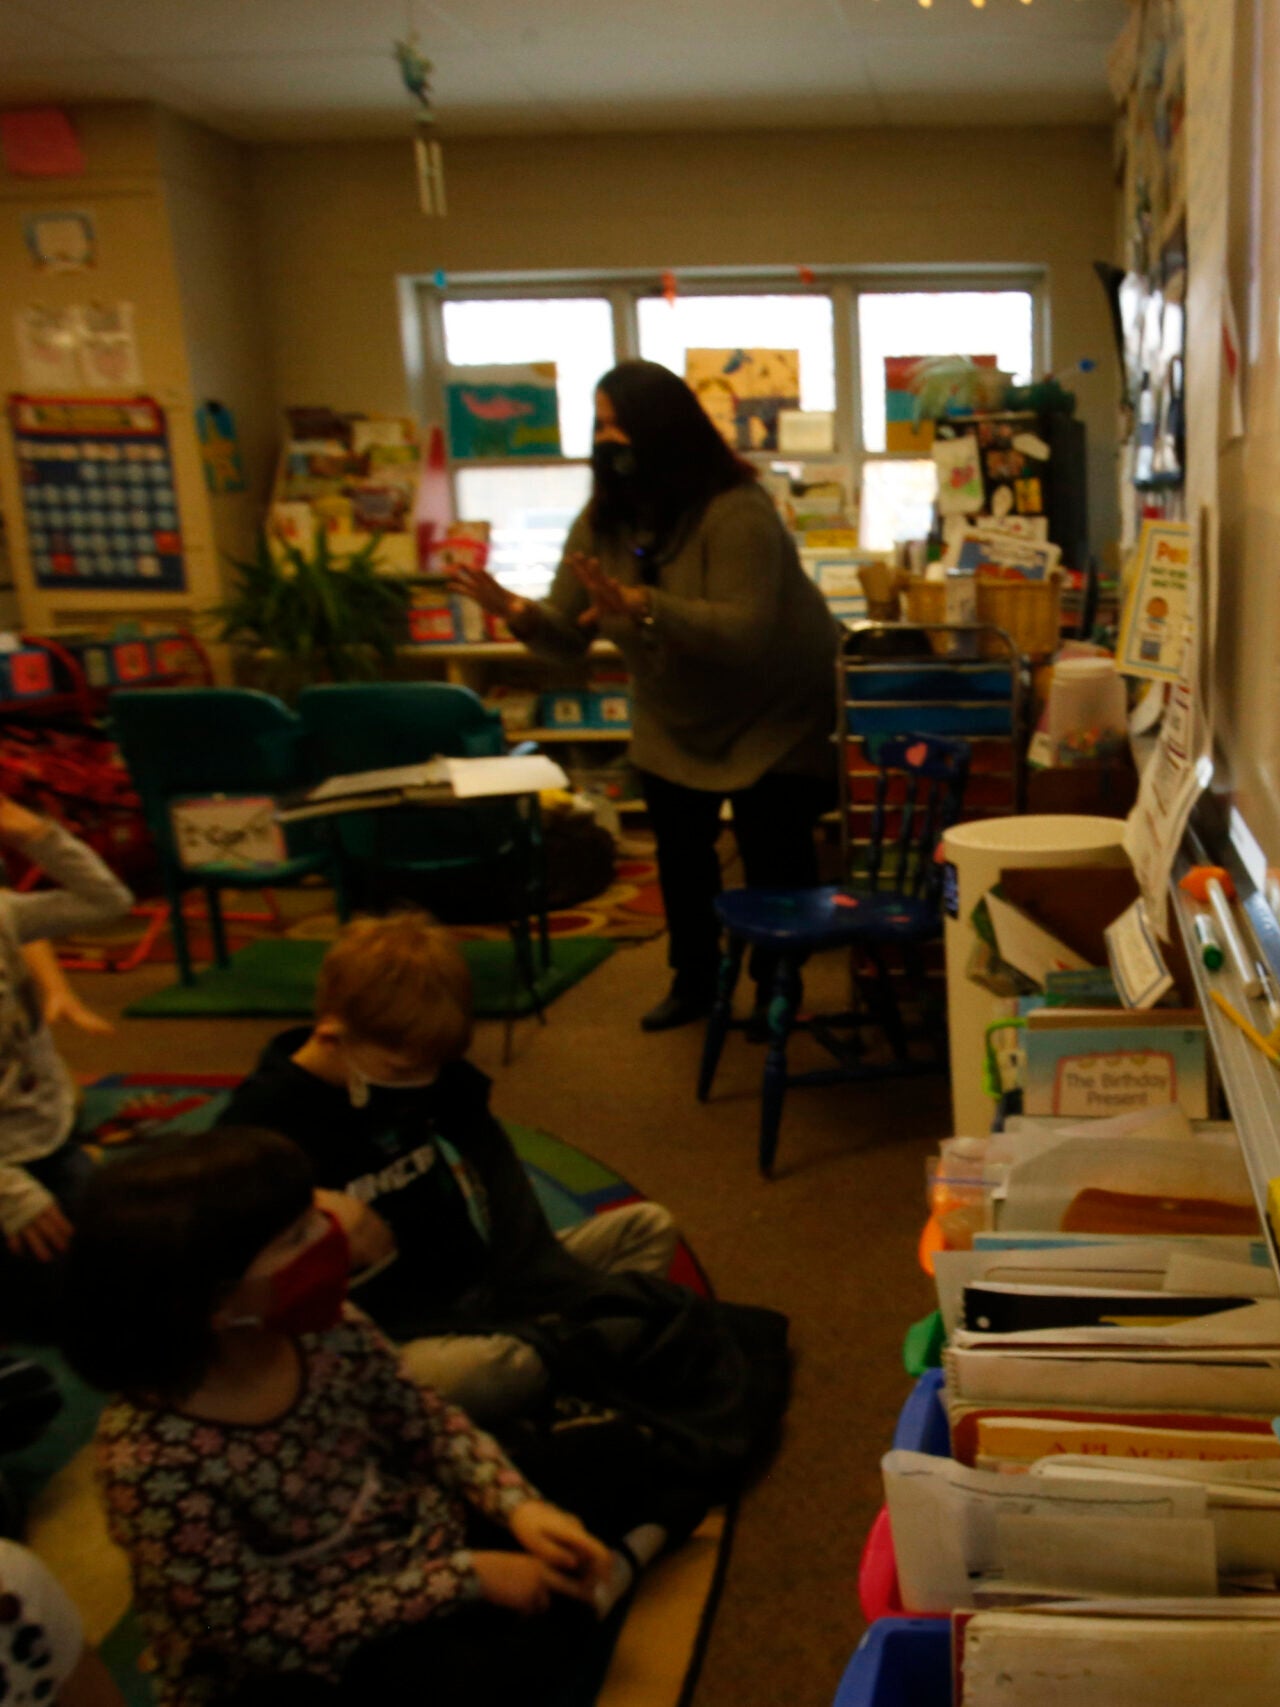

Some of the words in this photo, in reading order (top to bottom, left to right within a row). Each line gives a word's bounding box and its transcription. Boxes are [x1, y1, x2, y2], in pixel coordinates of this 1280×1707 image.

[1066, 1072, 1096, 1088] The
[1101, 1072, 1168, 1091] Birthday
[1086, 1090, 1149, 1106] Present
